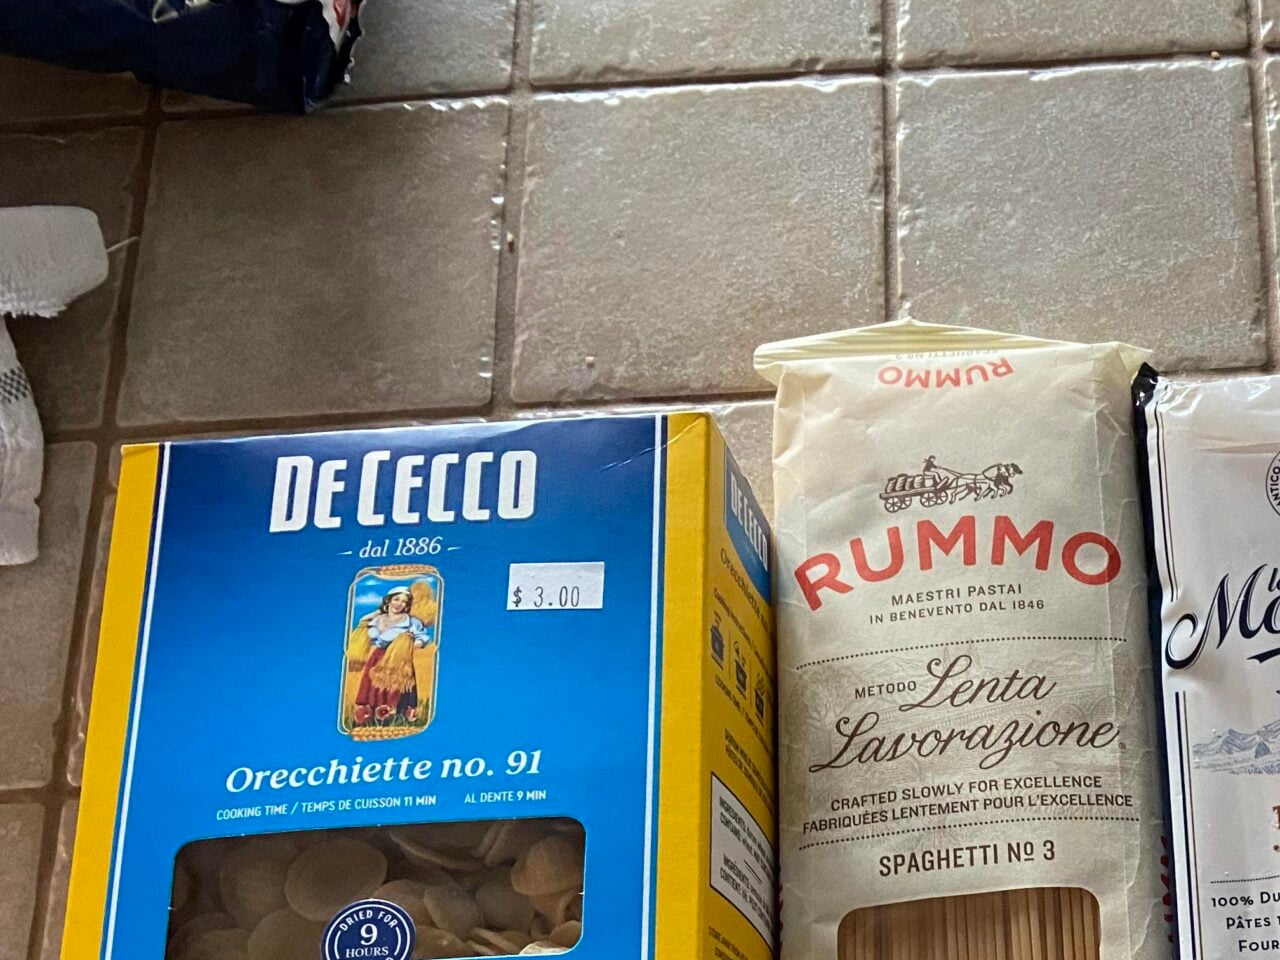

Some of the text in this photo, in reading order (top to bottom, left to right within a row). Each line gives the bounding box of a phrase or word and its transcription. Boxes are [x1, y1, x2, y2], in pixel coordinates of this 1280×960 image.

[878, 357, 1015, 388] RUMMO
[269, 450, 538, 533] DE CECCO
[359, 536, 443, 559] dal 1886
[794, 515, 1122, 611] RUMMO
[512, 585, 581, 608] $ 3.00
[891, 584, 1022, 606] MAESTRI PASTAI
[870, 599, 1044, 625] IN BENEVENTO DAL 1846
[855, 655, 1057, 712] METODO Lenta
[809, 710, 1120, 773] Lavorazione
[225, 749, 542, 793] Orecchiette no. 91
[216, 795, 437, 821] COOKING TIME TEMPS DE CUISSON 11 MIN
[464, 789, 547, 804] AL DENTE 9 MIN
[831, 776, 1102, 812] CRAFTED SLOWLY FOR EXCELLENCE
[803, 794, 1133, 835] FABRIQUÉES LENTEMENT POUR L'EXCELLENCE
[879, 844, 999, 877] SPAGHETTI
[1043, 840, 1055, 861] 3
[1211, 895, 1254, 908] 100%
[359, 923, 379, 945] 9
[345, 945, 389, 958] HOURS
